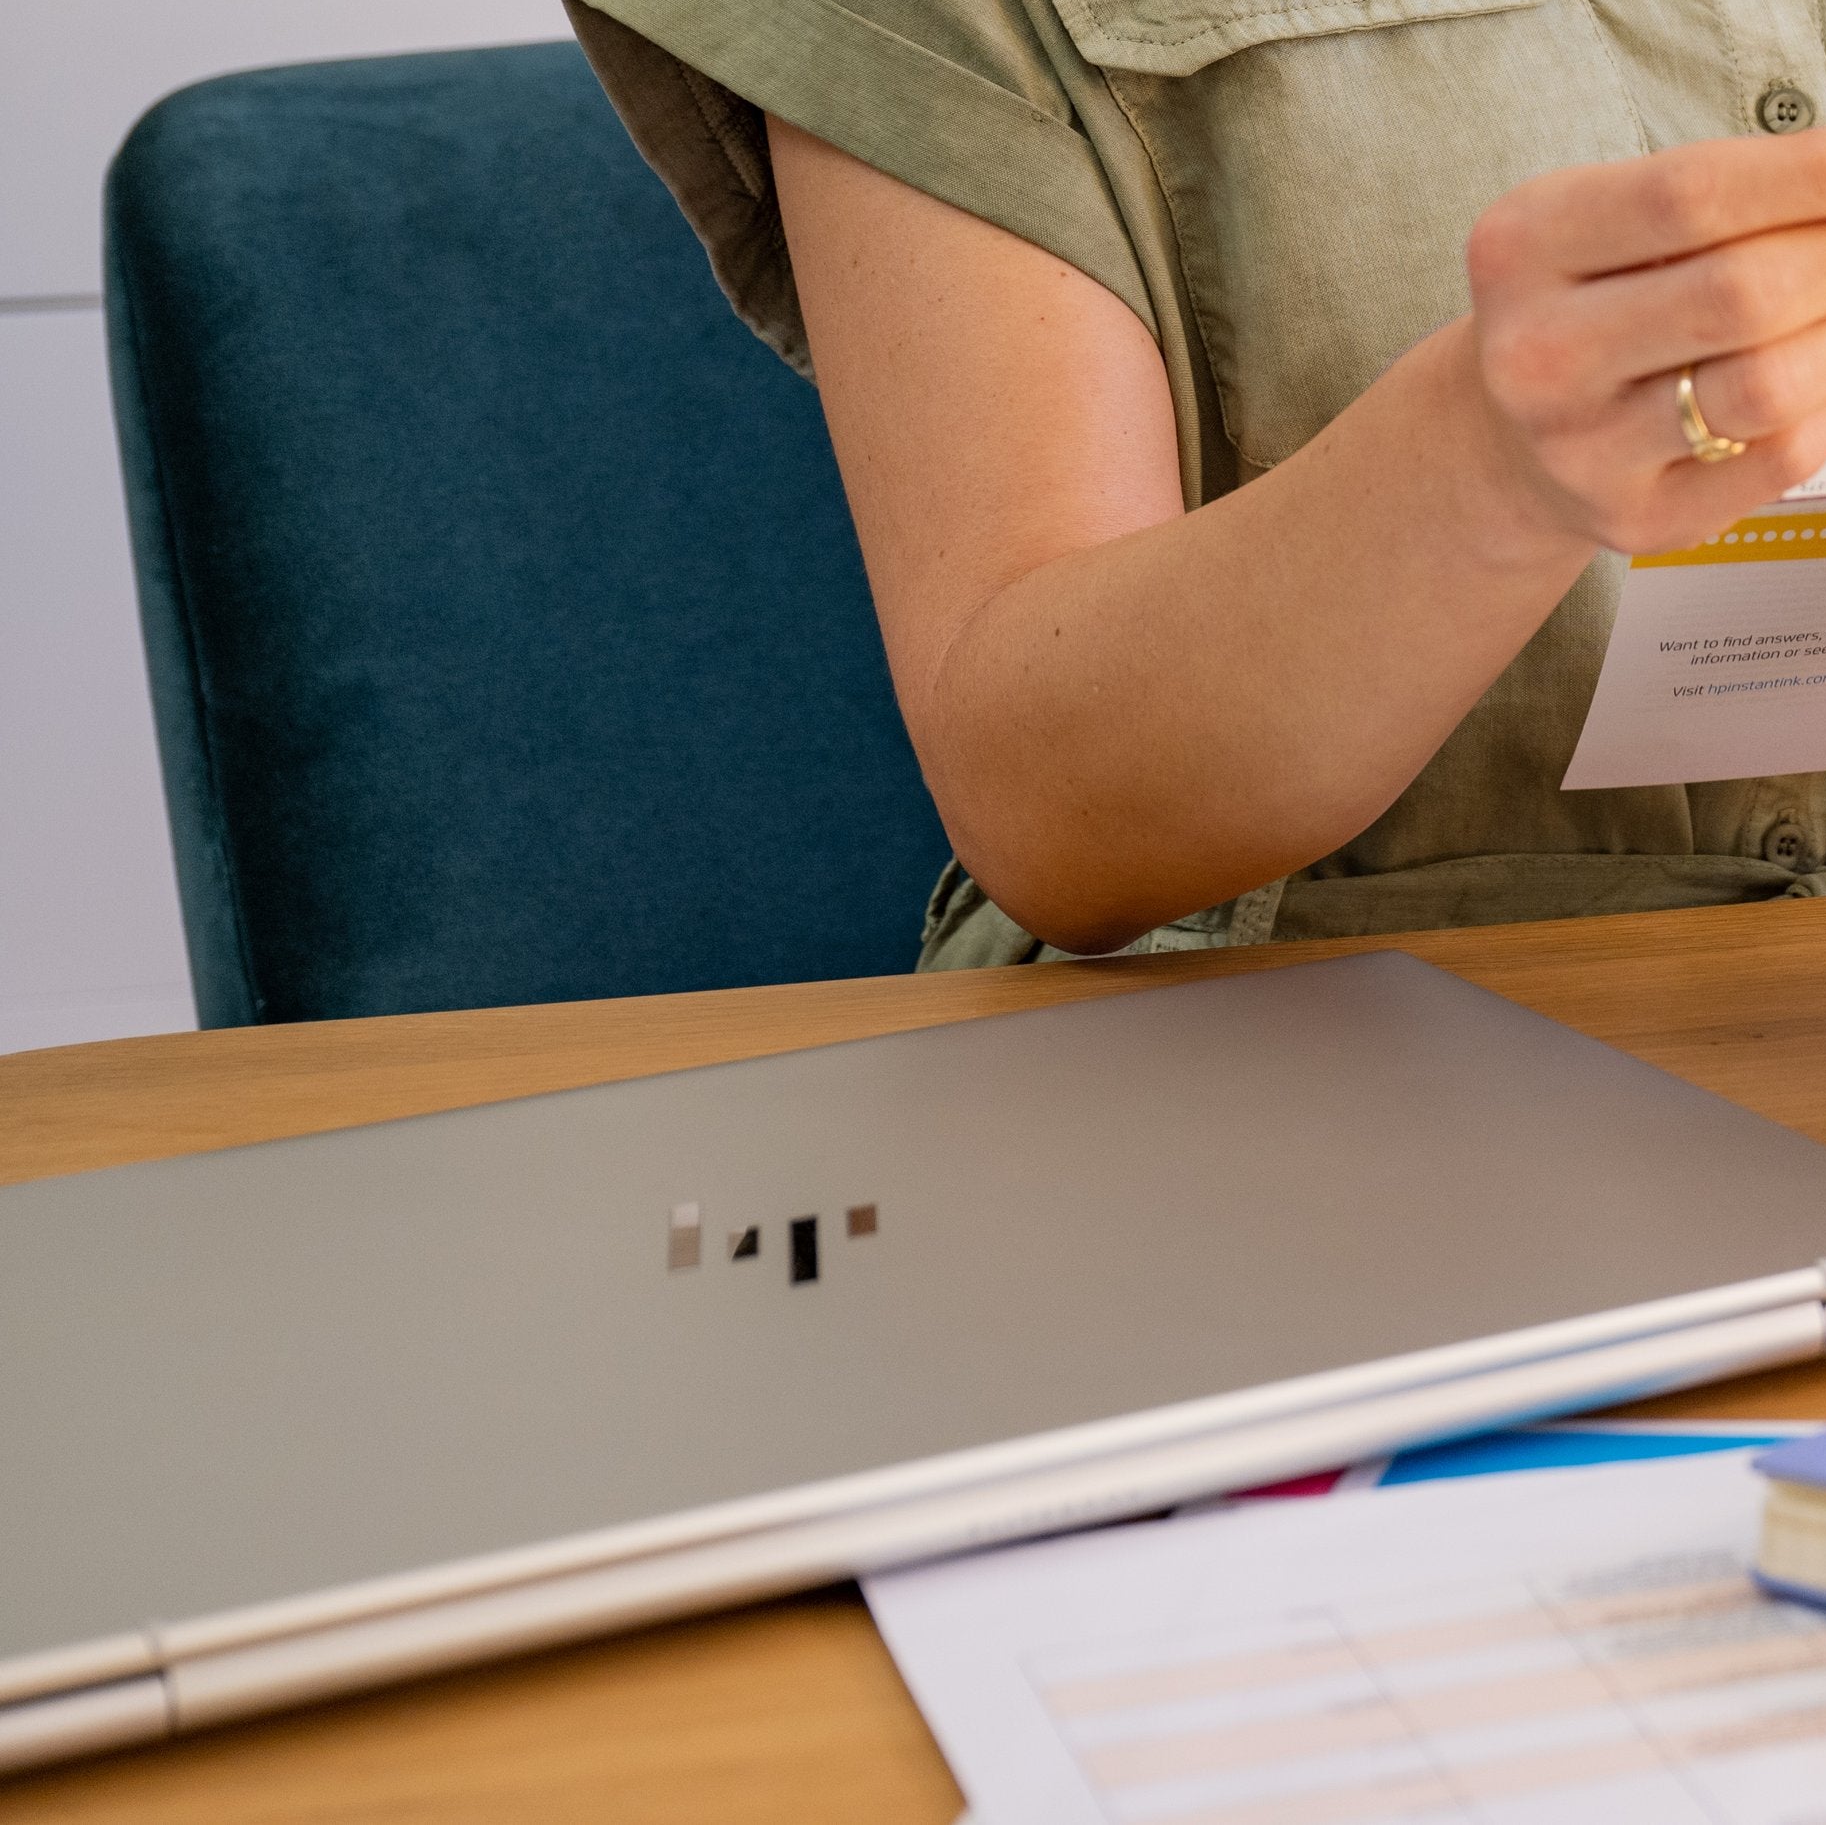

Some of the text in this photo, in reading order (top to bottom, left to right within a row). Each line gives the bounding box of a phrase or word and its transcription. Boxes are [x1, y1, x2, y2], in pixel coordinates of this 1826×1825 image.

[1659, 639, 1699, 653] Want
[1703, 638, 1719, 650] to
[1723, 634, 1754, 648] find
[1755, 629, 1823, 646] answers,
[1690, 649, 1780, 666] information
[1784, 647, 1801, 658] or
[1672, 684, 1705, 698] Visit
